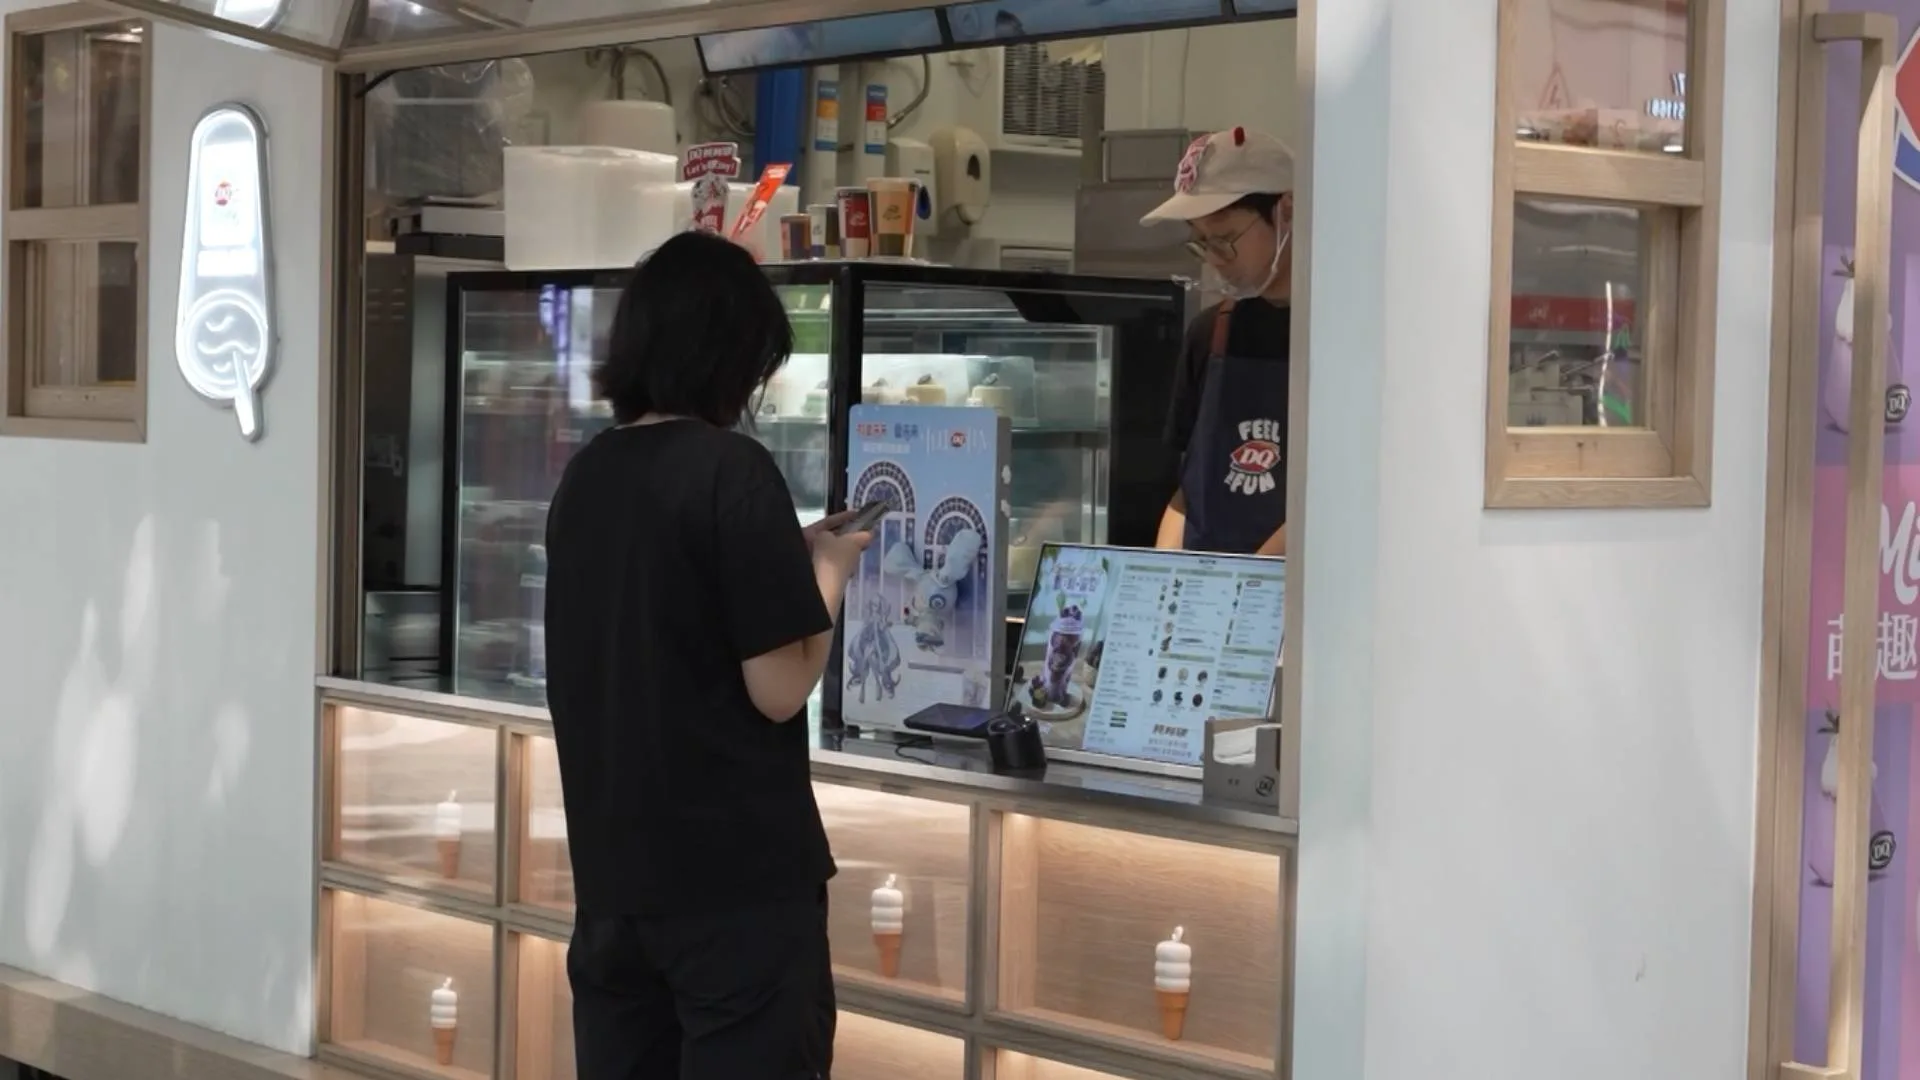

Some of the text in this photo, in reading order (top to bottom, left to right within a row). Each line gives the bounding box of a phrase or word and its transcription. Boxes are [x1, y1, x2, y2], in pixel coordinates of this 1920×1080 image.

[1238, 418, 1280, 443] FEEL
[1239, 447, 1274, 469] DQ
[1230, 471, 1276, 495] FUN
